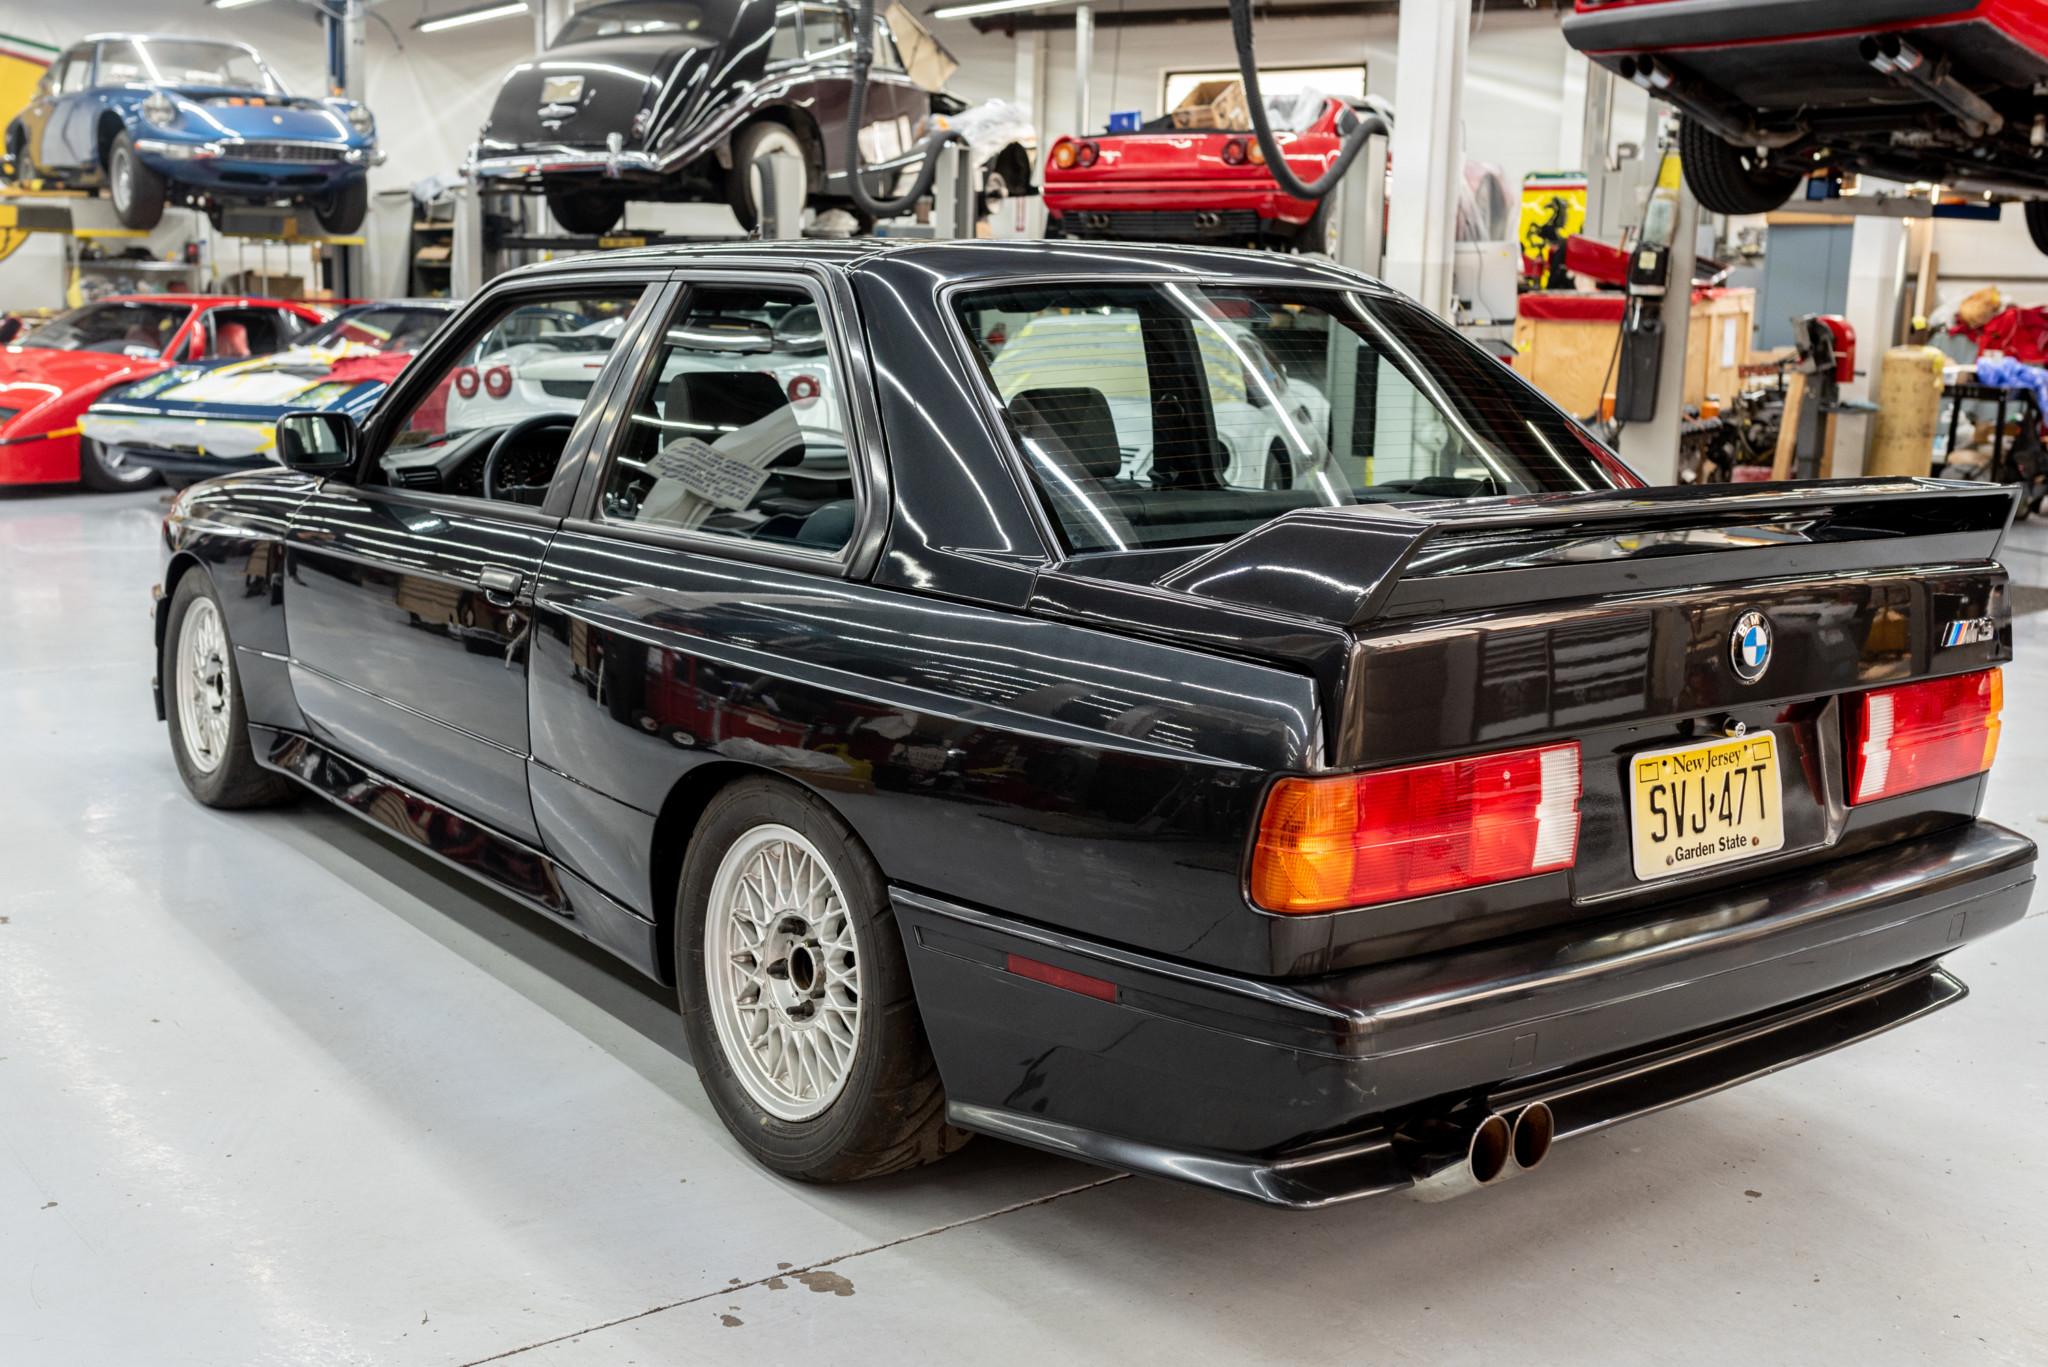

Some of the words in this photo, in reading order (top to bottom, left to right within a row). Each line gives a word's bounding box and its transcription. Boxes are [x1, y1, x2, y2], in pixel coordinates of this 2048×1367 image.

[1943, 616, 1995, 647] M3
[1672, 755, 1705, 775] New
[1705, 750, 1741, 773] Jersey
[1674, 842, 1715, 862] Garden
[1718, 834, 1747, 852] State
